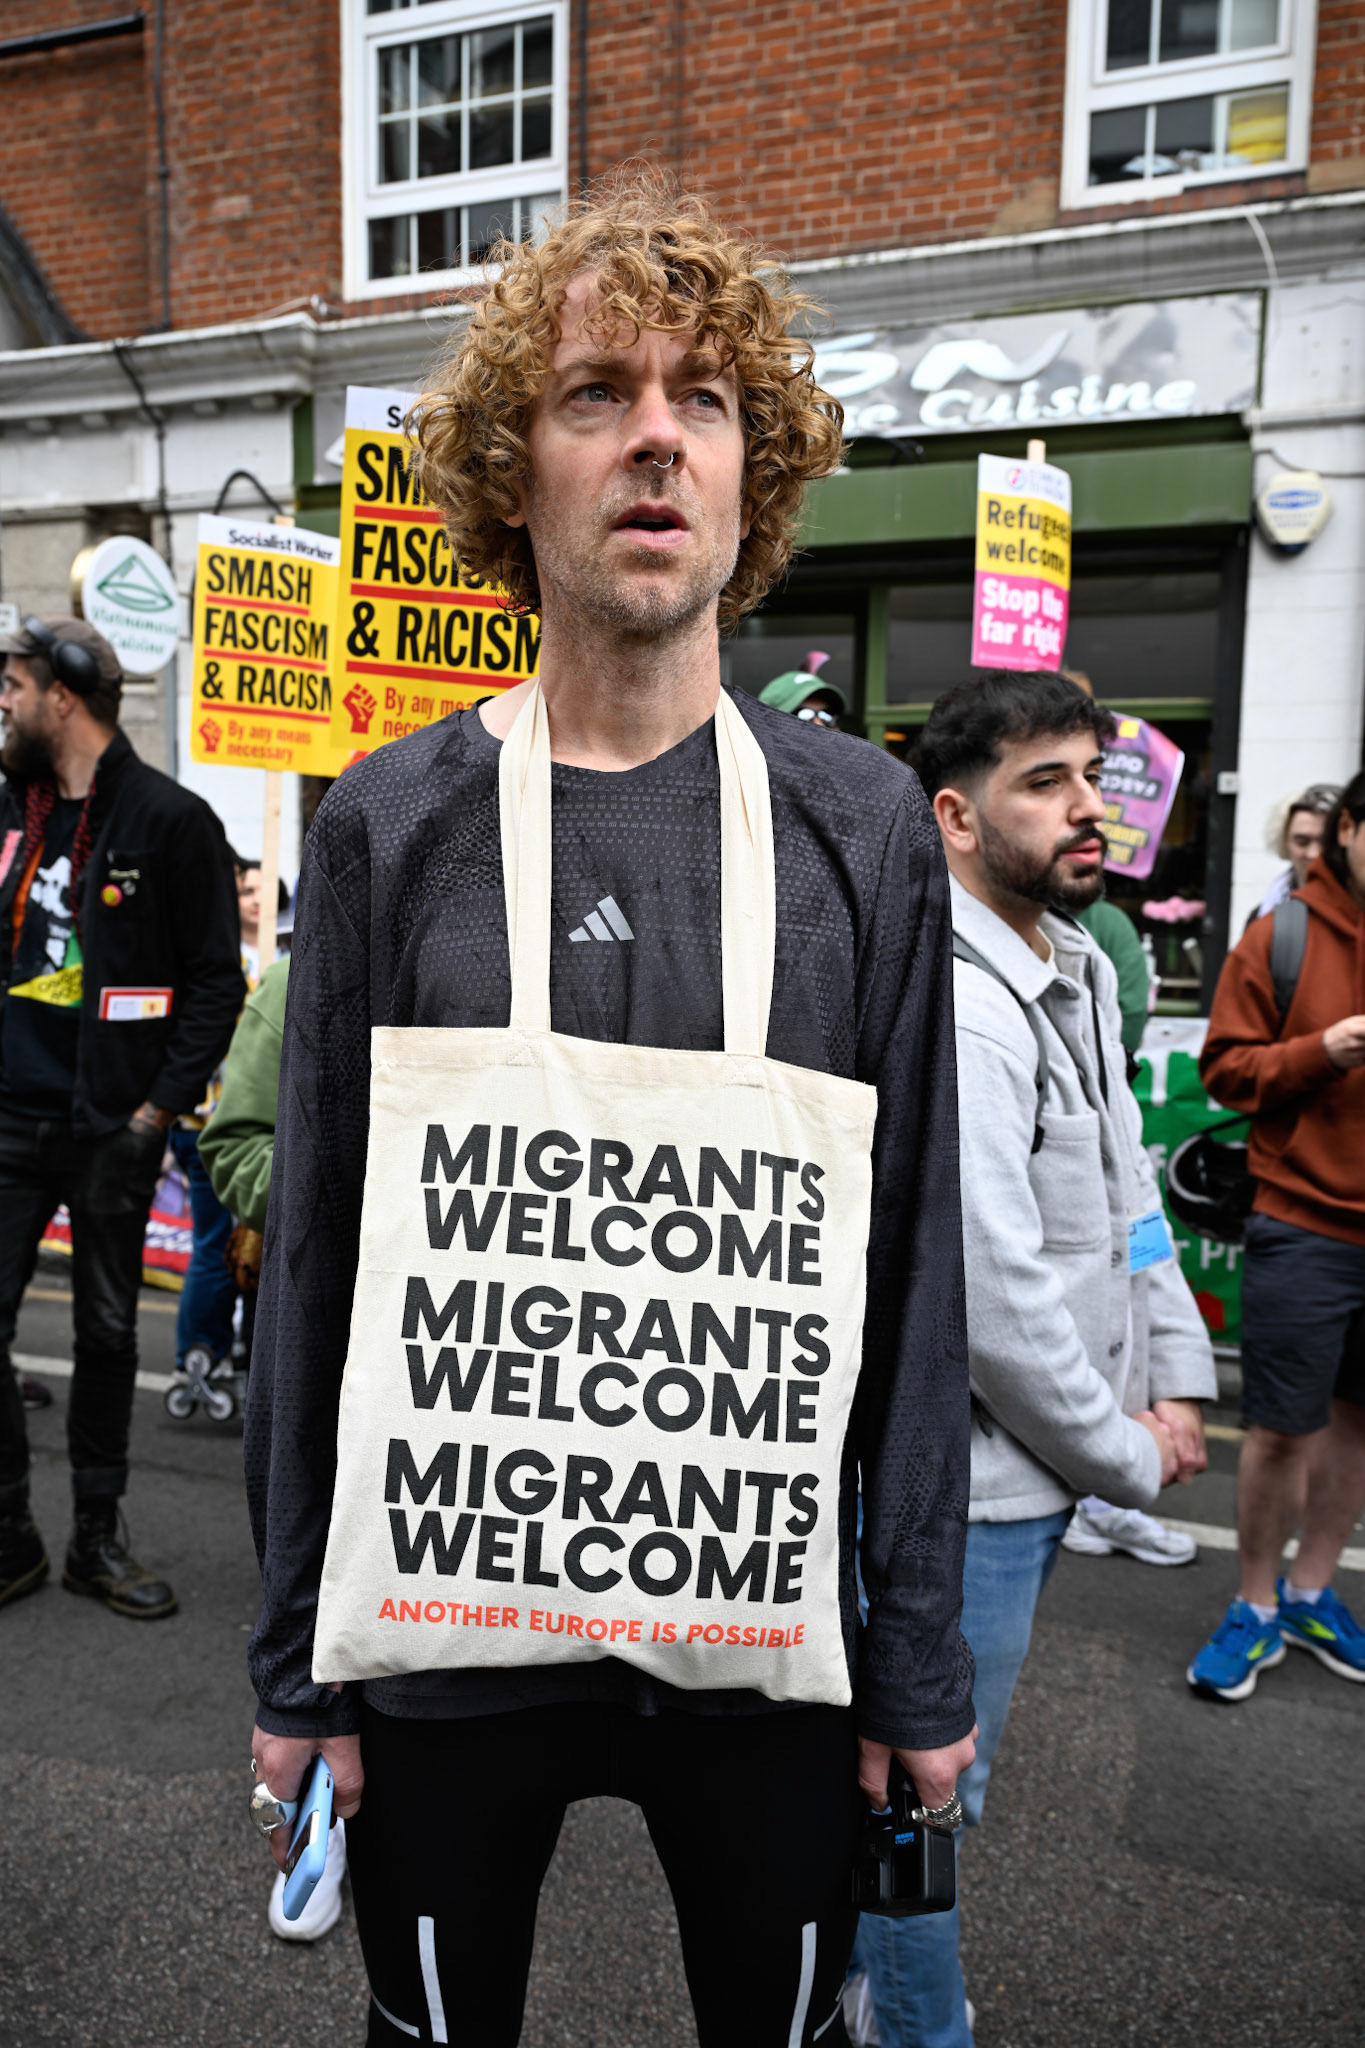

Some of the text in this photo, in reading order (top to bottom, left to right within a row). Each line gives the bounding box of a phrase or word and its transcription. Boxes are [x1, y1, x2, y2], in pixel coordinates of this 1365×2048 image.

[919, 375, 1197, 427] Cuisine
[229, 529, 333, 561] Socialist Worker
[986, 538, 1065, 575] welcome
[207, 553, 312, 605] SMASH
[982, 578, 1064, 621] Stop the
[205, 607, 328, 660] FASCISM
[347, 601, 379, 657] &
[980, 612, 1060, 657] far right
[201, 661, 224, 699] &
[385, 686, 406, 717] By
[411, 696, 435, 720] any
[227, 720, 312, 745] By any means
[227, 741, 293, 765] necessary
[421, 1124, 825, 1222] MIGRANTS
[424, 1188, 822, 1287] WELCOME
[401, 1276, 831, 1377] MIGRANTS
[405, 1344, 819, 1444] WELCOME
[384, 1438, 818, 1538] MIGRANTS
[389, 1508, 807, 1604] WELCOME
[378, 1598, 805, 1649] ANOTHER EUROPE IS POSSIBLE
